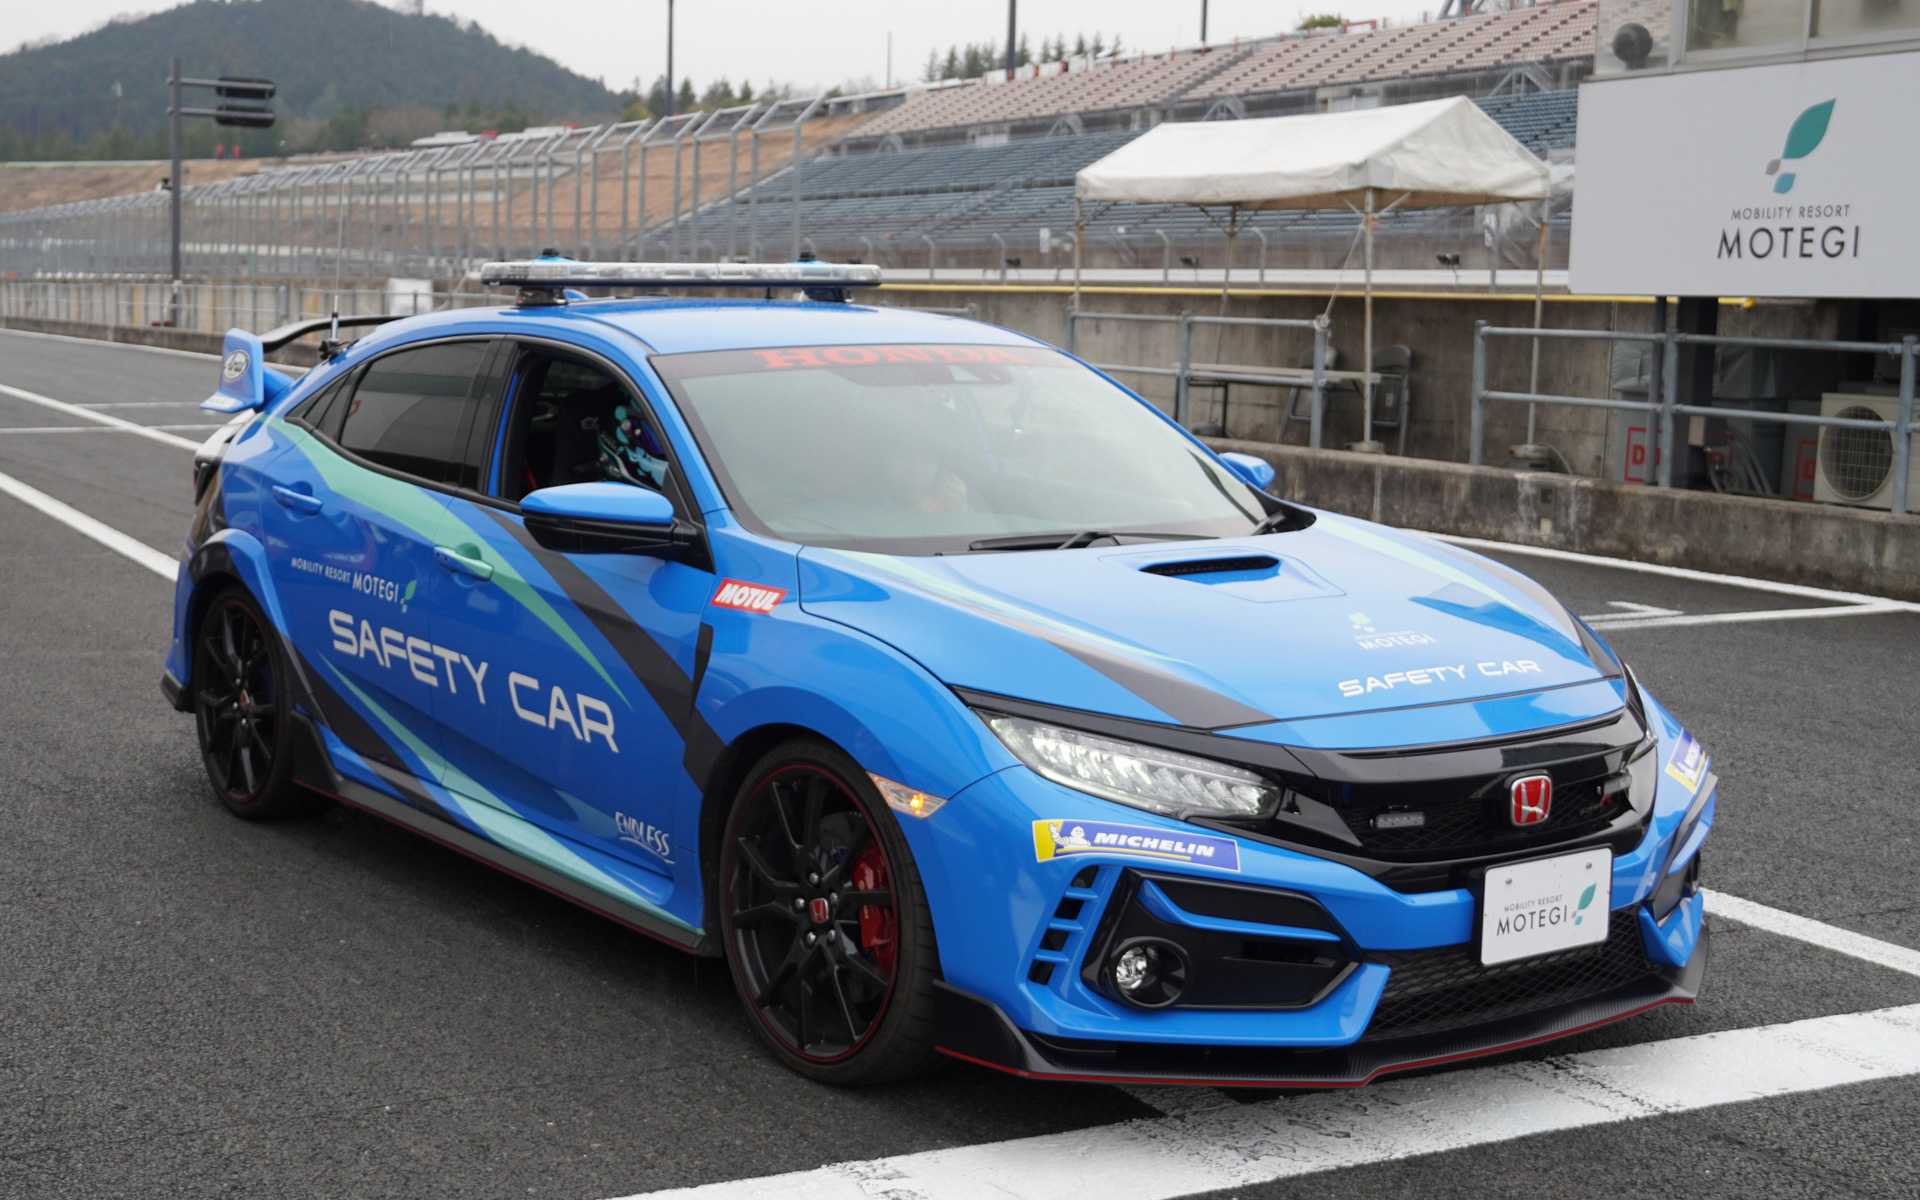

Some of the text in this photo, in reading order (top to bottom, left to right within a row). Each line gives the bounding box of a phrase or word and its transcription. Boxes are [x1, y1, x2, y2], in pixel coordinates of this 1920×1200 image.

[1731, 204, 1851, 220] MOBILITY RESORT
[1717, 225, 1859, 259] MOTEGI
[752, 346, 1033, 368] HONDA
[291, 557, 399, 602] MOBILITY RESORT MOTEGI
[714, 583, 780, 610] MOTUL
[1357, 633, 1436, 650] MOTEGI
[329, 609, 620, 753] SAFETY CAR
[1338, 660, 1542, 697] SAFETY CAR
[615, 811, 669, 856] ENDLESS
[1094, 832, 1215, 858] MICHELIN
[1504, 894, 1563, 912] MOBILITY RESORT
[1497, 904, 1567, 936] MOTEGI
